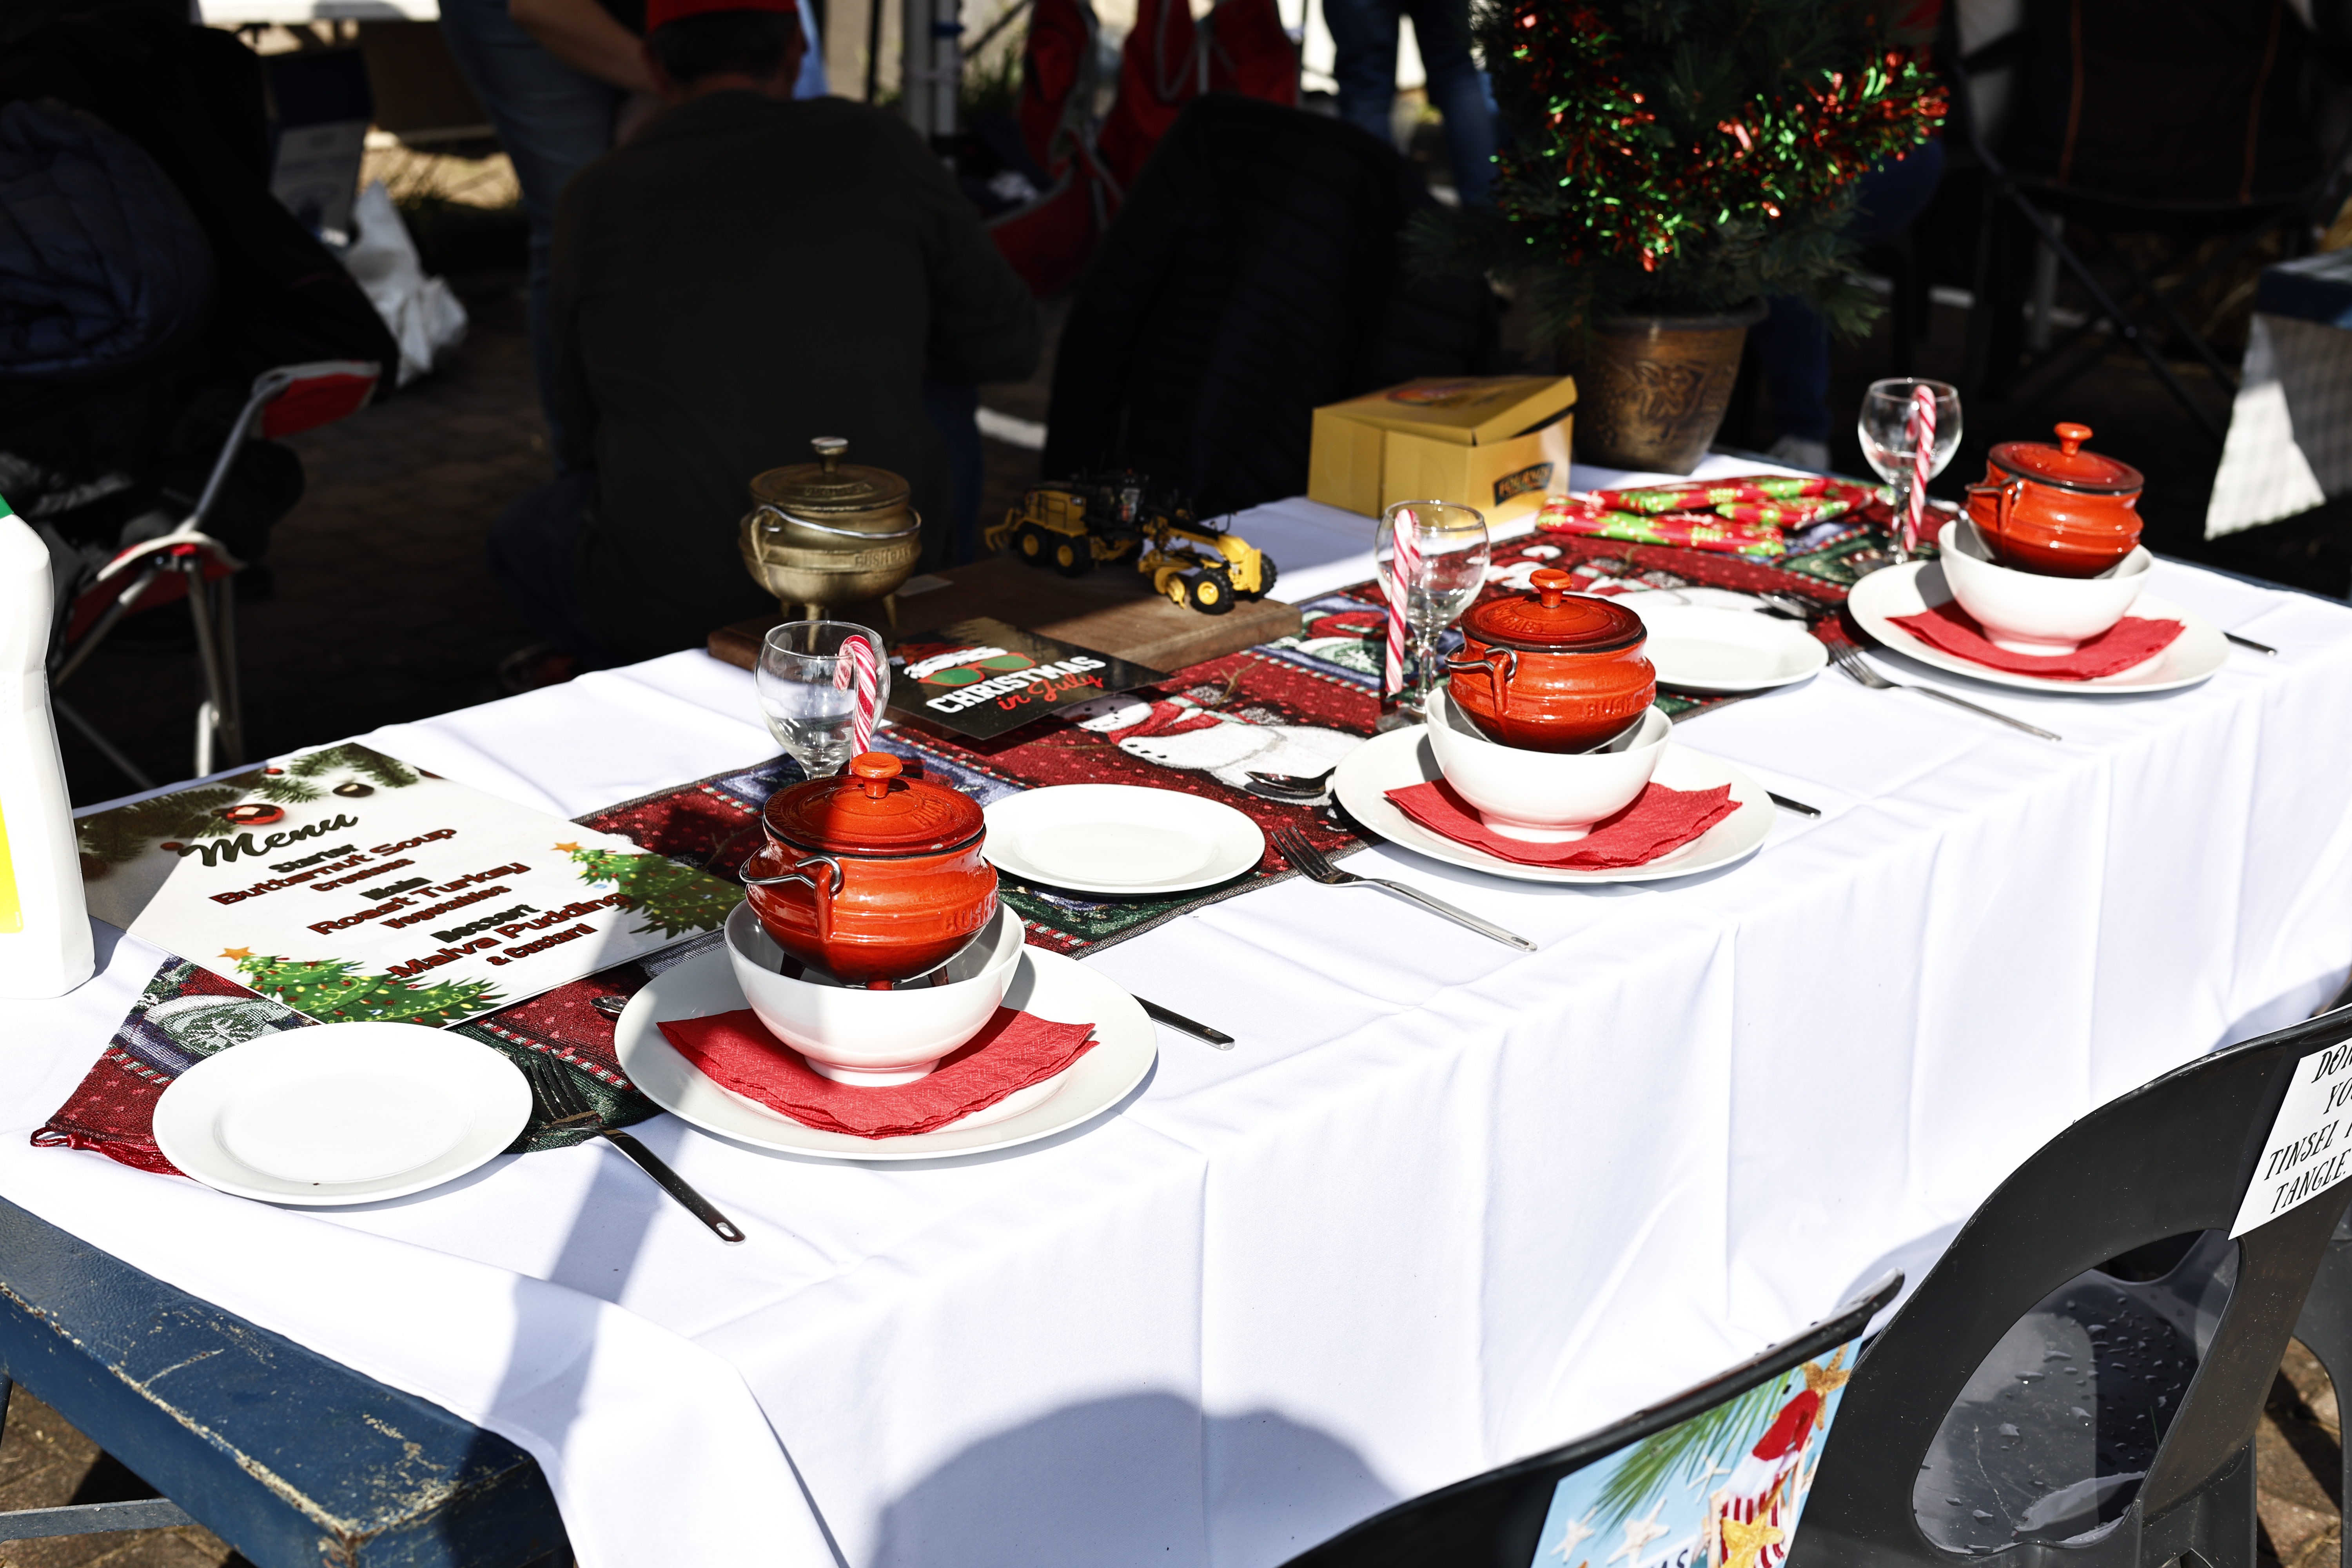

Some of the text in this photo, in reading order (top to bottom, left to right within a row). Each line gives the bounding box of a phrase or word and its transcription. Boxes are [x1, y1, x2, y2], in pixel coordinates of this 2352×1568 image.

[926, 656, 1106, 713] CHRISTMAS
[996, 673, 1104, 710] in July
[178, 814, 359, 867] Menu
[208, 829, 457, 905] Butternut Soup
[307, 862, 532, 935] Roast Turkey
[379, 886, 512, 929] Vegetables
[429, 904, 541, 943] Dessert
[385, 892, 633, 978] Malva Pudding
[486, 956, 514, 966] &
[2323, 1077, 2352, 1115] YO
[2264, 1120, 2339, 1181] TINSEL
[2270, 1148, 2352, 1214] TANGLE.
